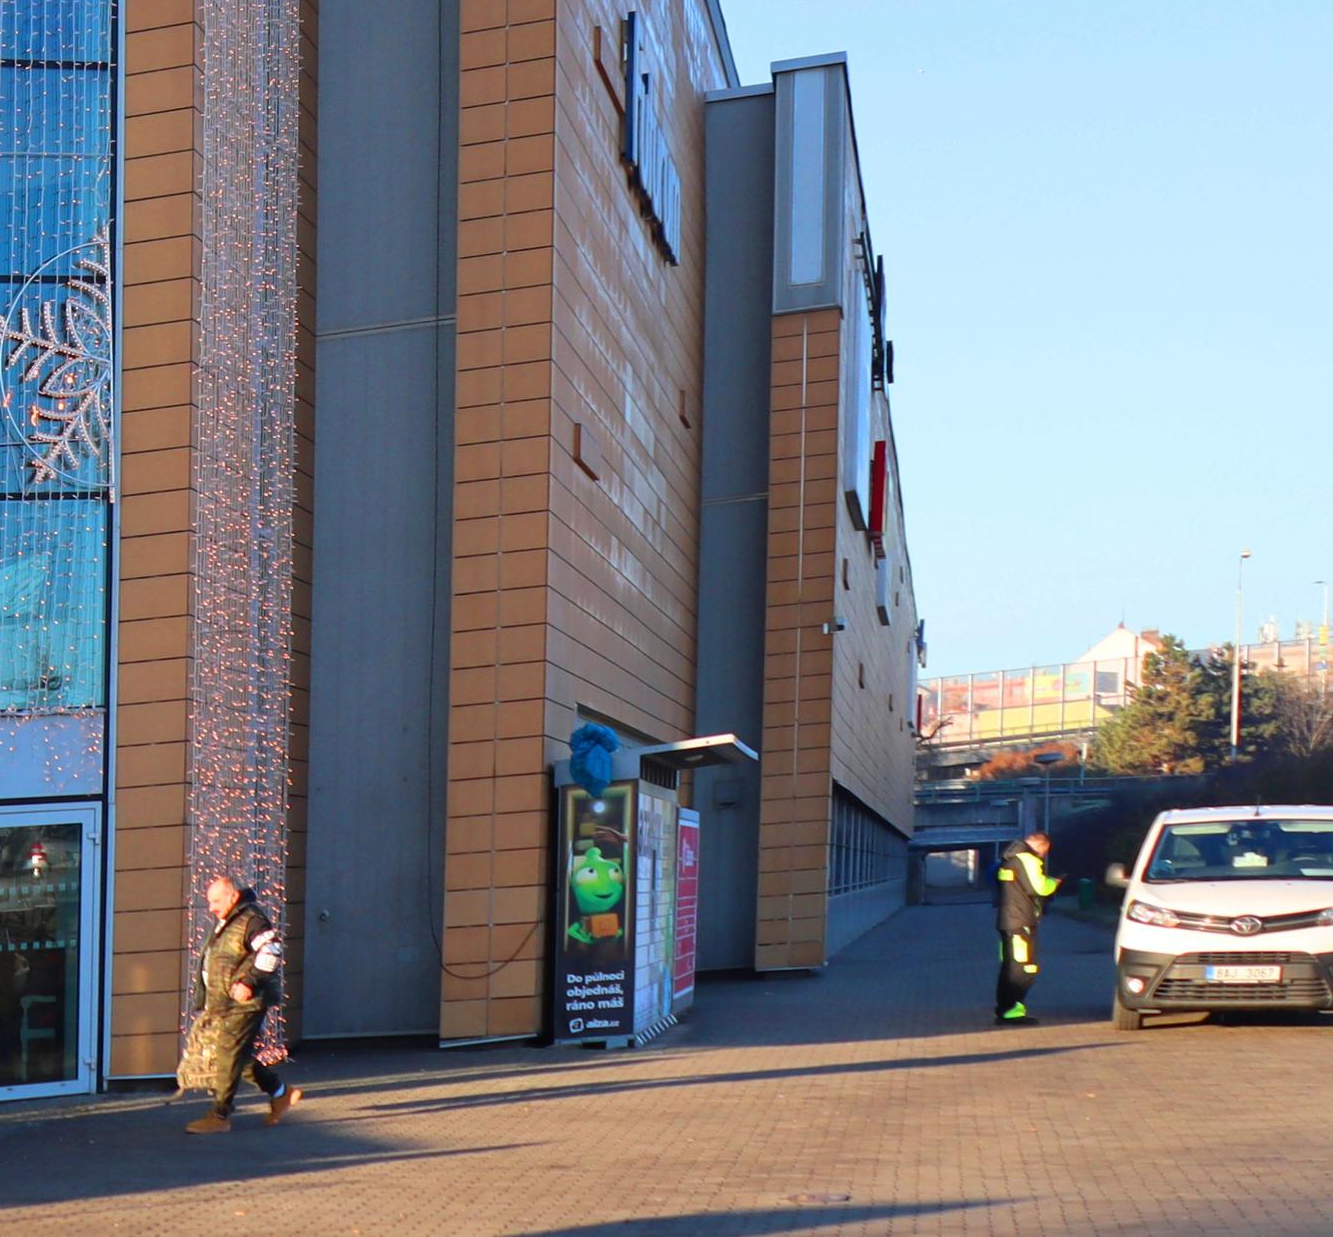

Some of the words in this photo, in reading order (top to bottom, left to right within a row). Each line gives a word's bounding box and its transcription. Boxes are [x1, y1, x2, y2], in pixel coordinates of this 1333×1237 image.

[566, 973, 583, 983] Do
[584, 970, 625, 985] půlnoci
[566, 1000, 595, 1011] ráno
[597, 996, 624, 1009] máš
